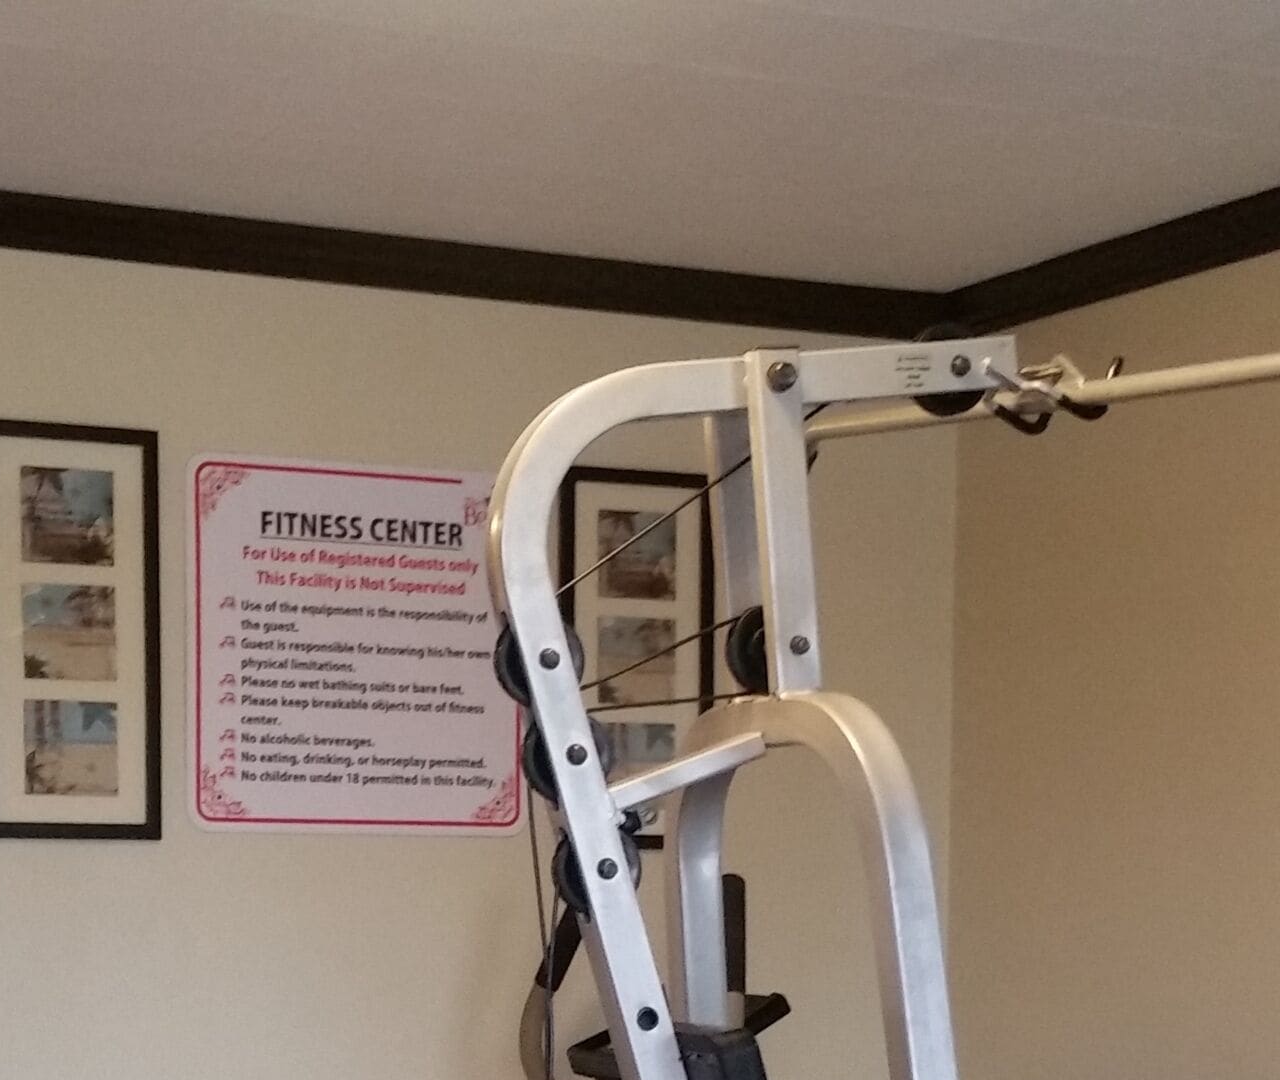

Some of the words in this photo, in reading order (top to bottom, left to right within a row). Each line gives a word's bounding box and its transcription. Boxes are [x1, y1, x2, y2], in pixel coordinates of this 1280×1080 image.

[261, 511, 363, 539] FITNESS
[370, 518, 462, 546] CENTER
[243, 546, 267, 560] For
[271, 548, 296, 562] Use
[300, 549, 315, 563] of
[319, 550, 395, 569] Registered
[399, 555, 446, 571] Guests
[448, 558, 478, 576] only
[257, 569, 285, 586] This
[289, 572, 342, 592] Facility
[345, 576, 357, 590] is
[359, 575, 384, 591] Not
[388, 578, 466, 596] Supervised
[241, 600, 262, 612] Use
[264, 600, 277, 613] of
[279, 602, 299, 613] the
[301, 604, 363, 617] equipment
[366, 608, 376, 618] is
[378, 607, 396, 618] the
[399, 609, 474, 624] responsibility
[475, 611, 488, 624] of
[241, 619, 260, 631] the
[263, 621, 299, 634] guest.
[241, 638, 274, 650] Guest
[277, 641, 286, 651] is
[288, 641, 354, 654] responsible
[357, 642, 374, 654] for
[376, 644, 425, 659] knowing
[427, 646, 465, 658] his/her
[467, 651, 491, 660] own
[241, 658, 288, 671] physical
[291, 659, 356, 673] limitations.
[241, 676, 278, 688] Please
[281, 679, 296, 689] no
[298, 680, 320, 690] wet
[322, 679, 367, 695] bathing
[370, 682, 395, 692] suits
[398, 684, 410, 694] or
[412, 683, 437, 694] bare
[439, 683, 464, 695] feet.
[241, 695, 278, 706] Please
[281, 697, 310, 710] keep
[312, 699, 369, 710] breakable
[371, 701, 411, 713] objects
[414, 702, 432, 713] out
[435, 702, 447, 713] of
[448, 702, 485, 714] fitness
[241, 716, 282, 726] center.
[241, 733, 257, 744] No
[260, 734, 311, 745] alcoholic
[313, 736, 375, 750] beverages.
[241, 752, 257, 763] No
[260, 754, 300, 767] eating,
[302, 753, 355, 768] drinking,
[357, 757, 370, 766] or
[371, 755, 426, 770] horseplay
[429, 757, 487, 770] permitted.
[241, 770, 257, 782] No
[260, 771, 307, 783] children
[309, 772, 343, 783] under
[346, 773, 360, 784] 18
[362, 775, 418, 787] permitted
[420, 777, 431, 786] in
[433, 775, 453, 786] this
